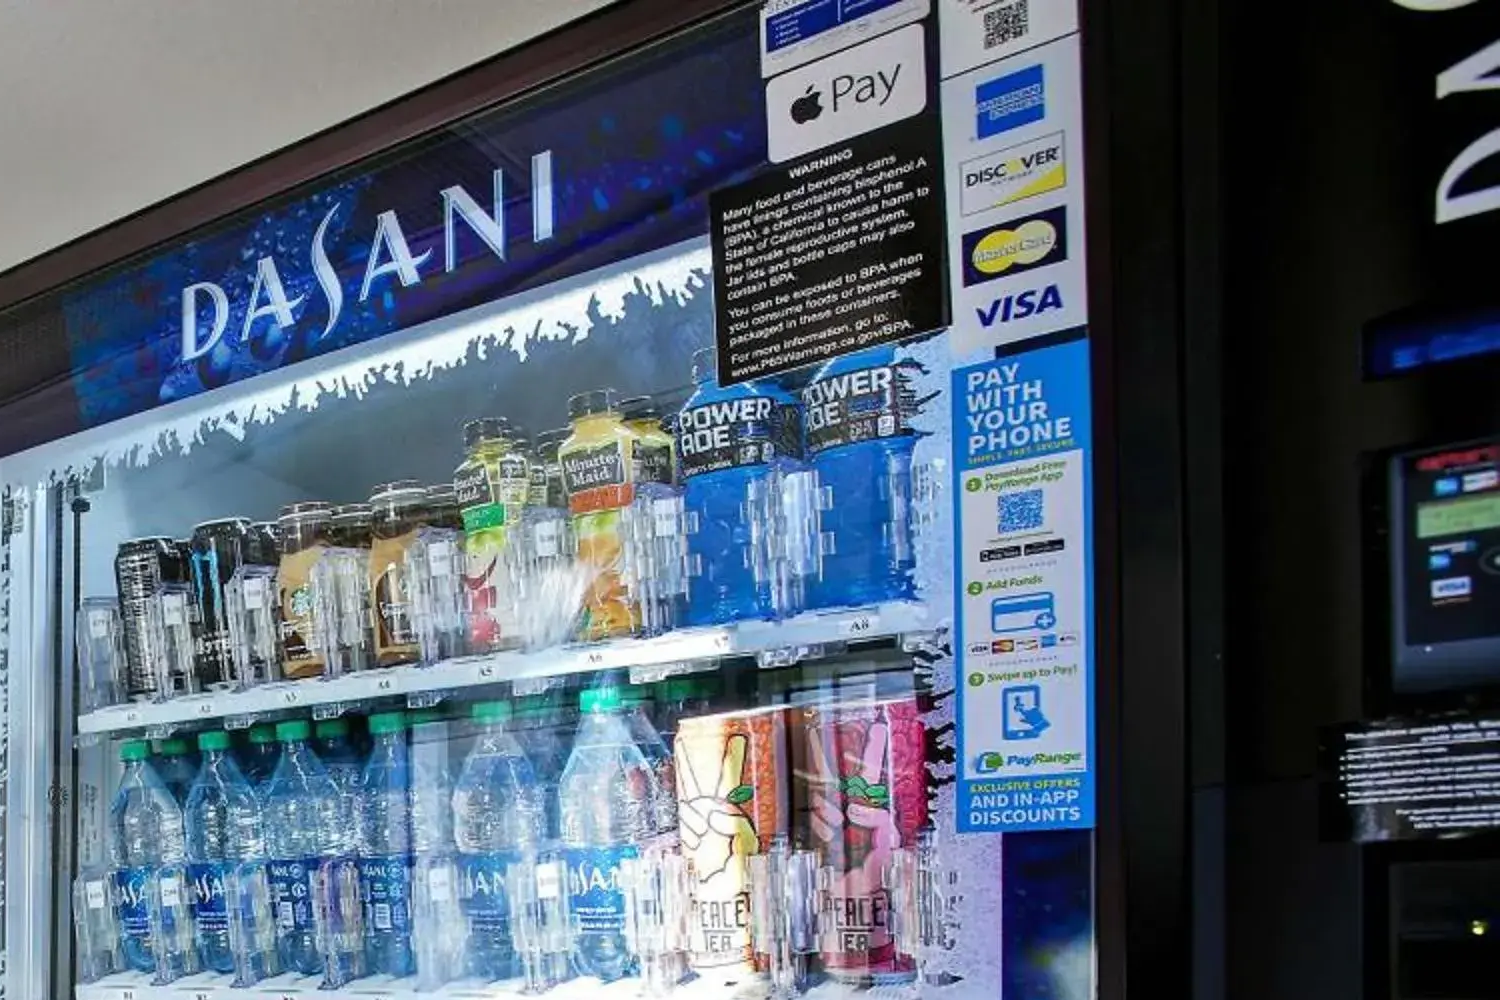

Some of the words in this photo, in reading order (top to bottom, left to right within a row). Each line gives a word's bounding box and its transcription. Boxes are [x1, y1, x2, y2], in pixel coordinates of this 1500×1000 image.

[832, 63, 902, 113] Pay
[788, 149, 853, 179] WARNING
[965, 145, 1060, 188] DISCOVER
[723, 204, 752, 221] Many
[755, 194, 781, 210] food
[783, 184, 805, 201] and
[807, 167, 864, 192] beverage
[866, 155, 897, 172] cans
[792, 184, 853, 211] containing
[855, 160, 914, 190] bisphenol
[725, 245, 755, 261] State
[756, 238, 768, 251] of
[769, 221, 825, 246] California
[827, 216, 840, 228] to
[841, 203, 879, 223] cause
[881, 191, 915, 209] harm
[917, 187, 929, 198] to
[772, 206, 824, 232] chemical
[826, 193, 867, 214] known
[869, 188, 881, 199] to
[883, 181, 904, 195] the
[182, 150, 553, 362] DASANI
[725, 261, 743, 274] the
[786, 224, 859, 254] reproductive
[861, 209, 909, 231] system.
[726, 275, 745, 287] Jar
[768, 259, 791, 274] and
[793, 248, 825, 267] bottle
[827, 239, 857, 256] caps
[859, 229, 887, 246] may
[889, 220, 916, 236] also
[727, 281, 767, 301] contain
[728, 306, 750, 319] You
[752, 299, 773, 313] can
[775, 293, 791, 305] be
[792, 275, 844, 301] exposed
[845, 272, 857, 284] to
[859, 262, 888, 280] BPA
[889, 251, 924, 271] when
[729, 320, 750, 336] you
[751, 303, 804, 327] consume
[805, 292, 839, 310] foods
[841, 286, 855, 299] or
[856, 267, 922, 296] beverages
[729, 322, 784, 350] packaged
[785, 318, 798, 330] in
[799, 308, 833, 326] these
[835, 288, 902, 316] containers.
[975, 283, 1065, 328] VISA
[731, 351, 751, 366] For
[752, 343, 781, 361] more
[783, 323, 853, 351] information,
[855, 317, 871, 332] go
[967, 362, 1021, 393] PAY
[966, 378, 1043, 415] WITH
[680, 397, 772, 435] POWER
[966, 400, 1049, 434] YOUR
[681, 425, 731, 457] ADE
[968, 416, 1073, 456] PHONE
[565, 450, 621, 474] Minute
[572, 467, 612, 488] Maid
[986, 578, 1008, 591] Add
[1010, 575, 1044, 588] Funds
[987, 670, 1021, 684] Swipe
[1022, 669, 1037, 682] up
[1039, 667, 1051, 677] to
[1007, 750, 1082, 767] PayRange
[970, 781, 1032, 794] EXCLUSIVE
[1033, 777, 1081, 790] OFFERS
[970, 795, 1009, 809] AND
[1014, 788, 1080, 807] IN-APP
[970, 805, 1082, 826] DISCOUNTS
[690, 894, 750, 929] PEACE
[823, 892, 886, 927] PEACE
[703, 929, 735, 953] TEA
[838, 928, 872, 953] TEA
